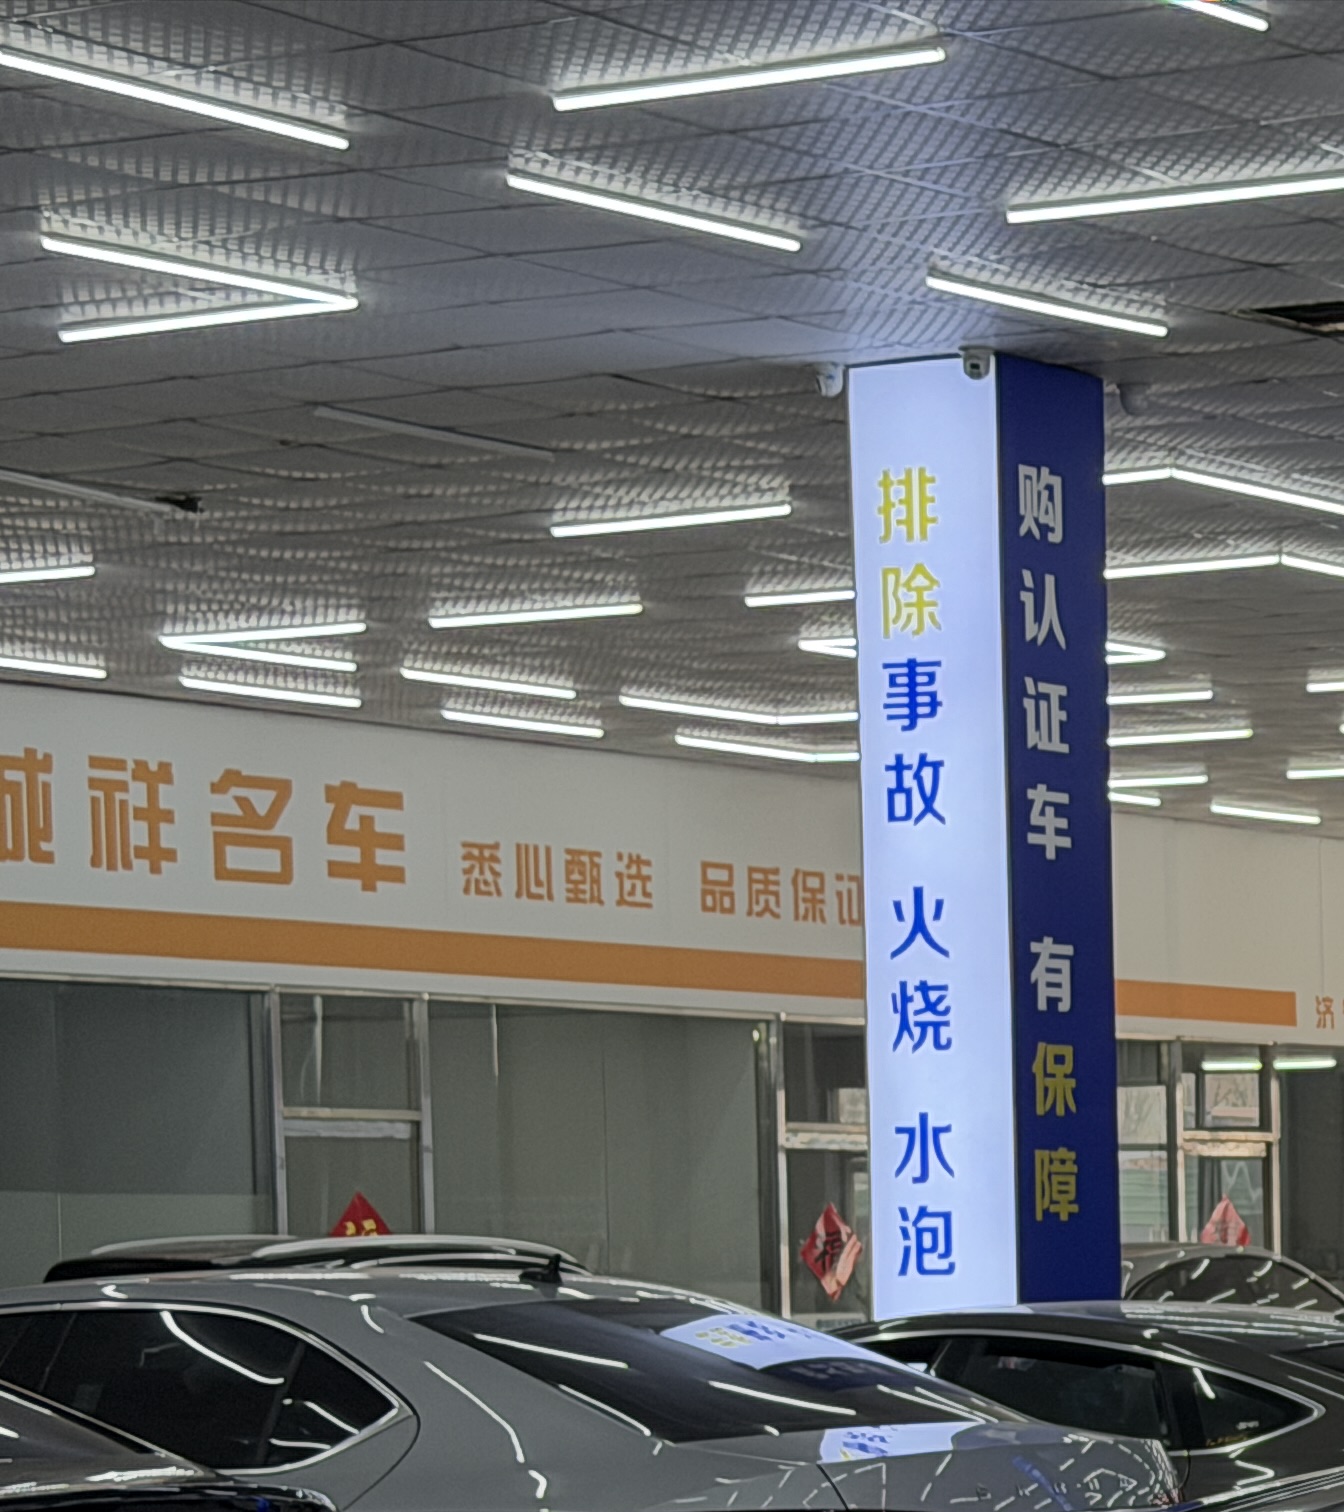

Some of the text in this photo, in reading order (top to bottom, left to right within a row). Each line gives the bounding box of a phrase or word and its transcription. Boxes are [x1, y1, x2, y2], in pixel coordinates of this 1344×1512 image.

[460, 840, 654, 910] 悉心甄选
[876, 466, 956, 1278] 排除事故 火烧 水泡
[1017, 463, 1080, 1223] 购认证车 有保障
